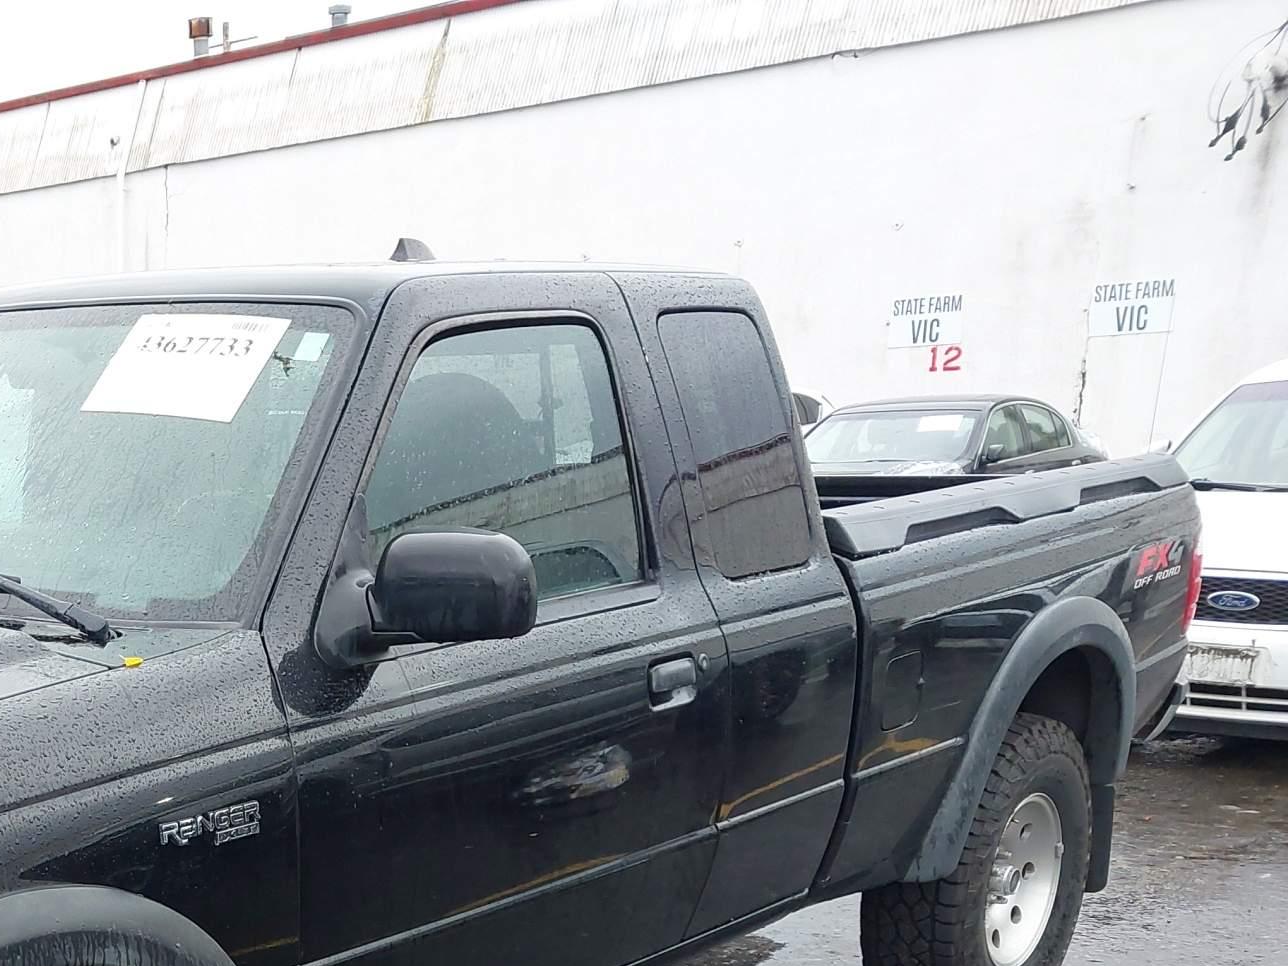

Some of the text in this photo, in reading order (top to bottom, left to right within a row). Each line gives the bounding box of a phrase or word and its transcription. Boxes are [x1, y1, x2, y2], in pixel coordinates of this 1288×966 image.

[1094, 279, 1175, 302] STATE FARM
[893, 294, 962, 316] STATE FARM
[912, 318, 940, 344] VIC
[1116, 305, 1148, 332] VIC
[928, 346, 962, 372] 12
[1137, 540, 1184, 576] FX4
[1134, 565, 1182, 590] OFF ROAD
[159, 801, 261, 846] RANGER
